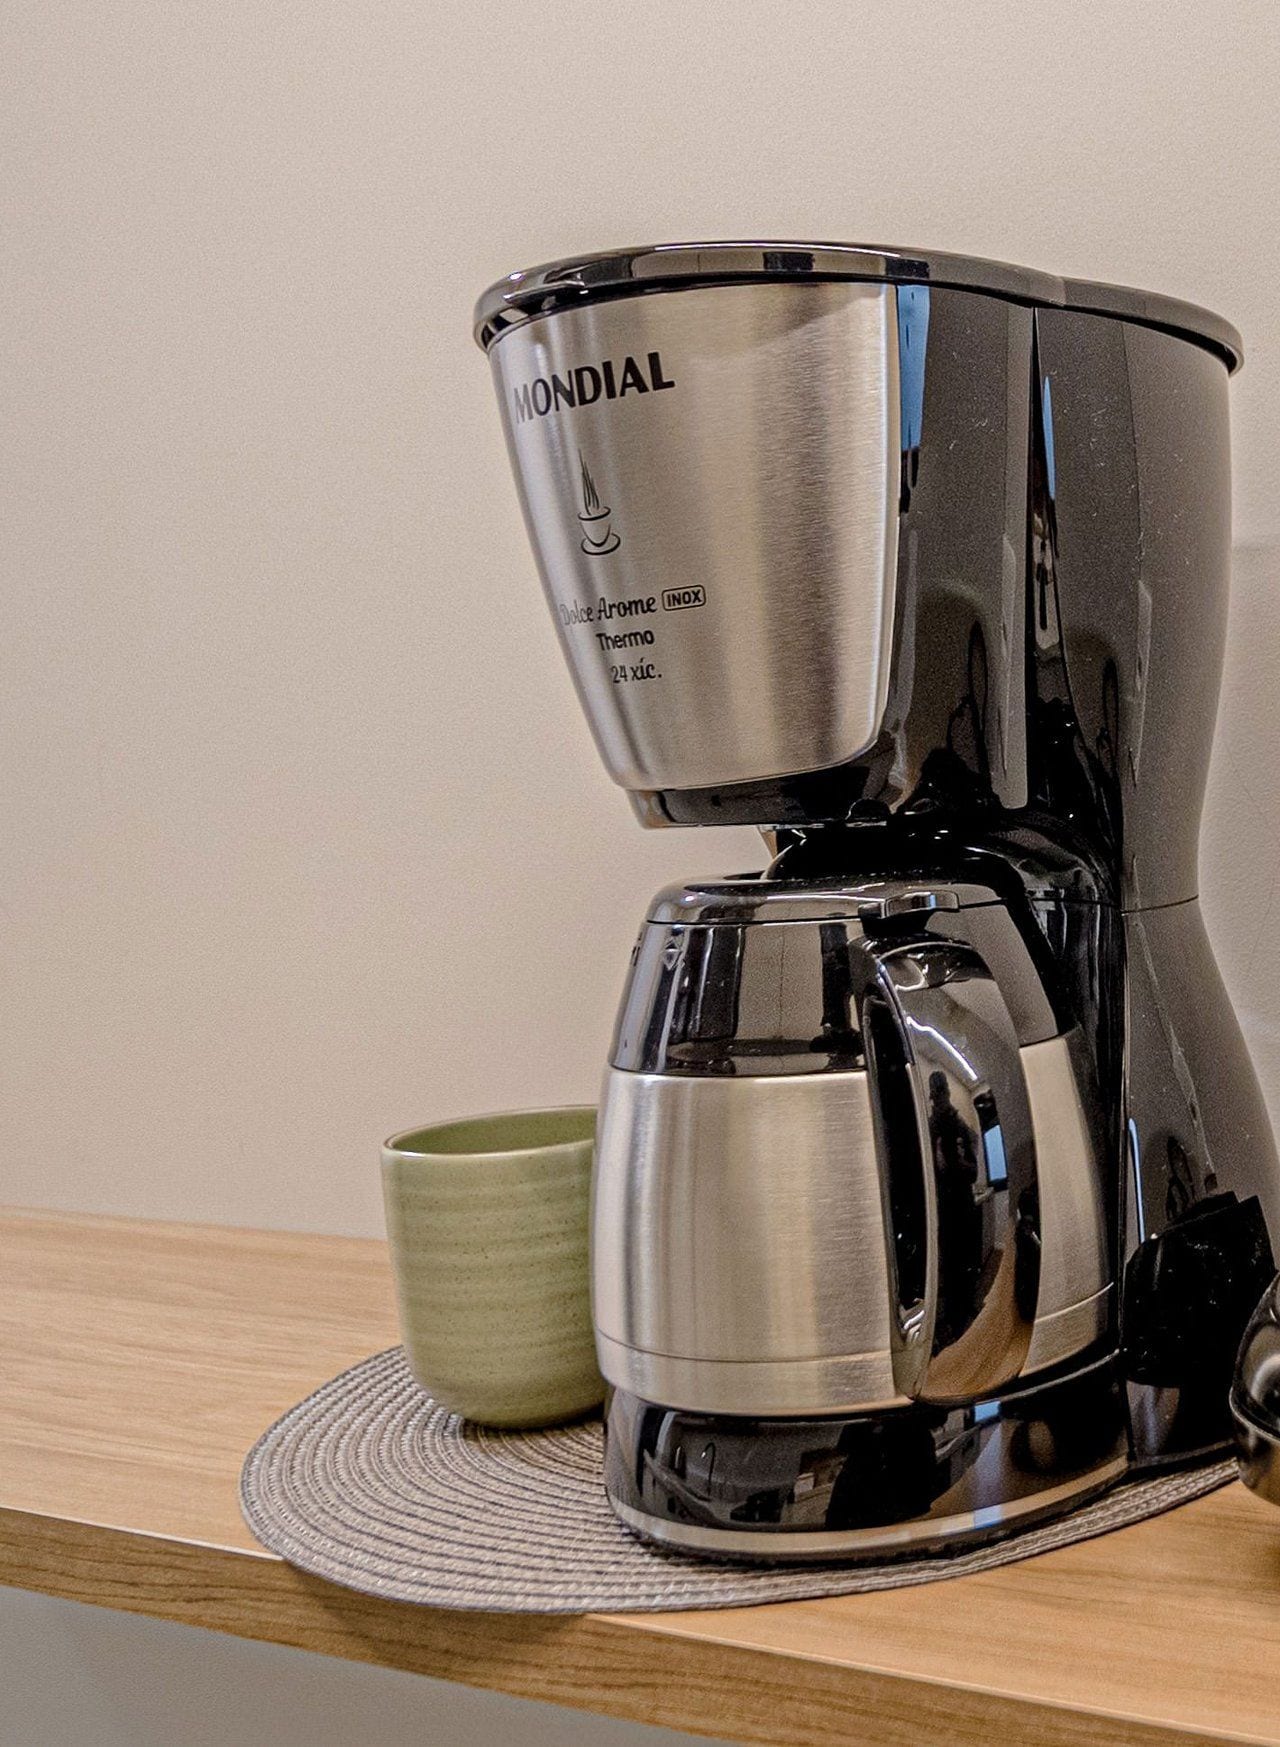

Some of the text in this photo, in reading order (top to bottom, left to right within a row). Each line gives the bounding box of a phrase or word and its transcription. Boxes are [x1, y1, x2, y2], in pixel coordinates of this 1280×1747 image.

[514, 352, 675, 424] MONDIAL
[561, 590, 702, 625] Dolce Arome INOX
[596, 629, 655, 651] Thermo
[611, 657, 662, 684] 24 xíc.
